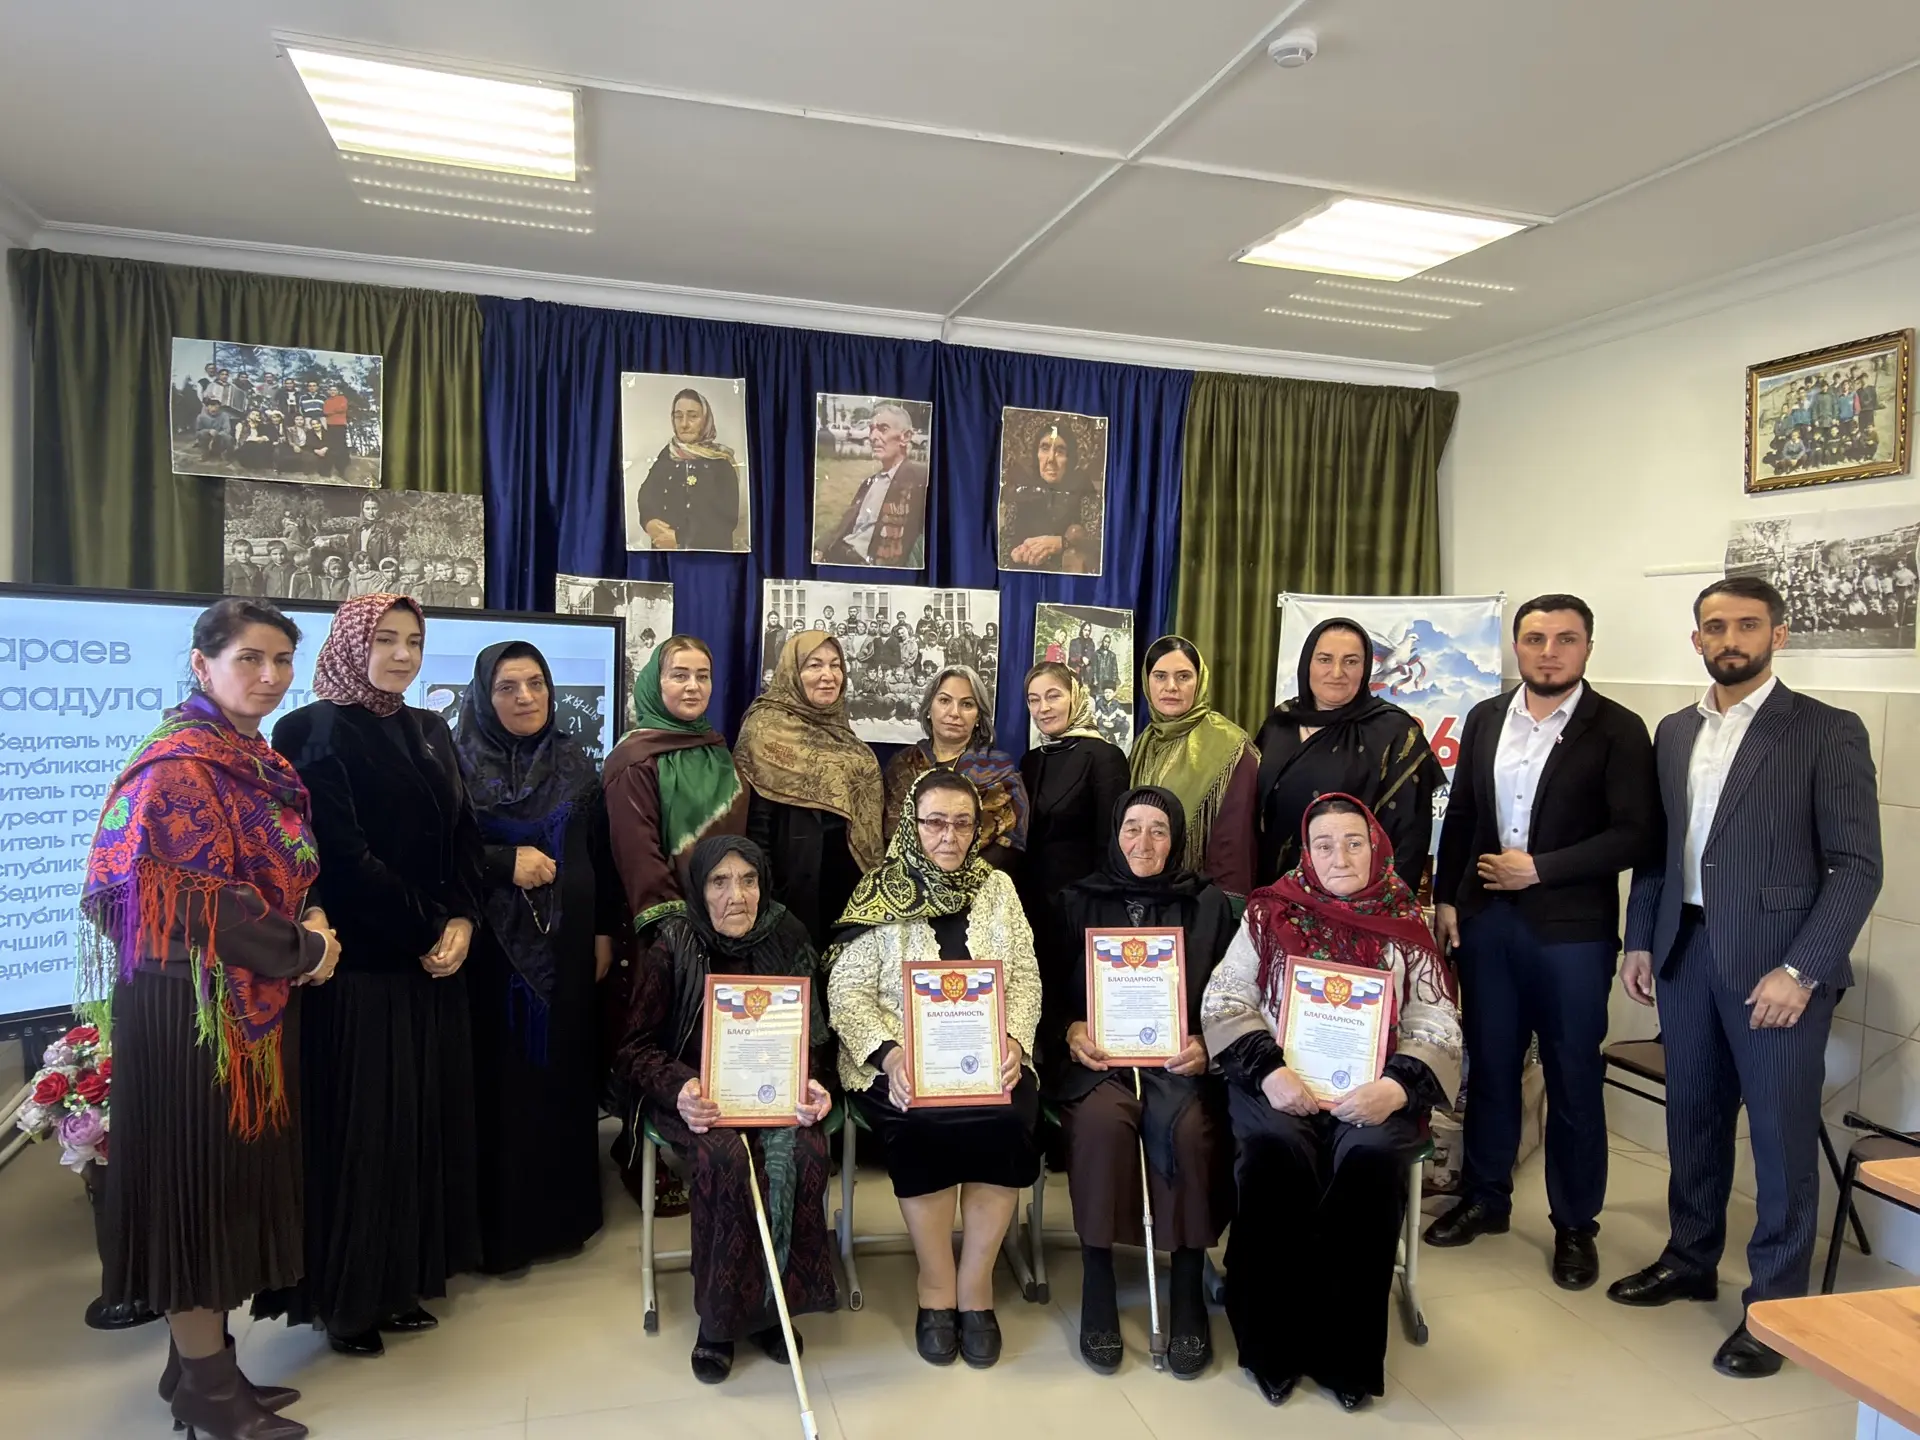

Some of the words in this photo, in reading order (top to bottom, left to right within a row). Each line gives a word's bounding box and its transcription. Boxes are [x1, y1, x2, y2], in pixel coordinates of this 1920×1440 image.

[0, 686, 162, 717] аадула
[927, 1010, 984, 1018] БЛАГОДАРНОСТЬ
[1304, 1010, 1365, 1026] БЛАГОДАРНОСТЬ
